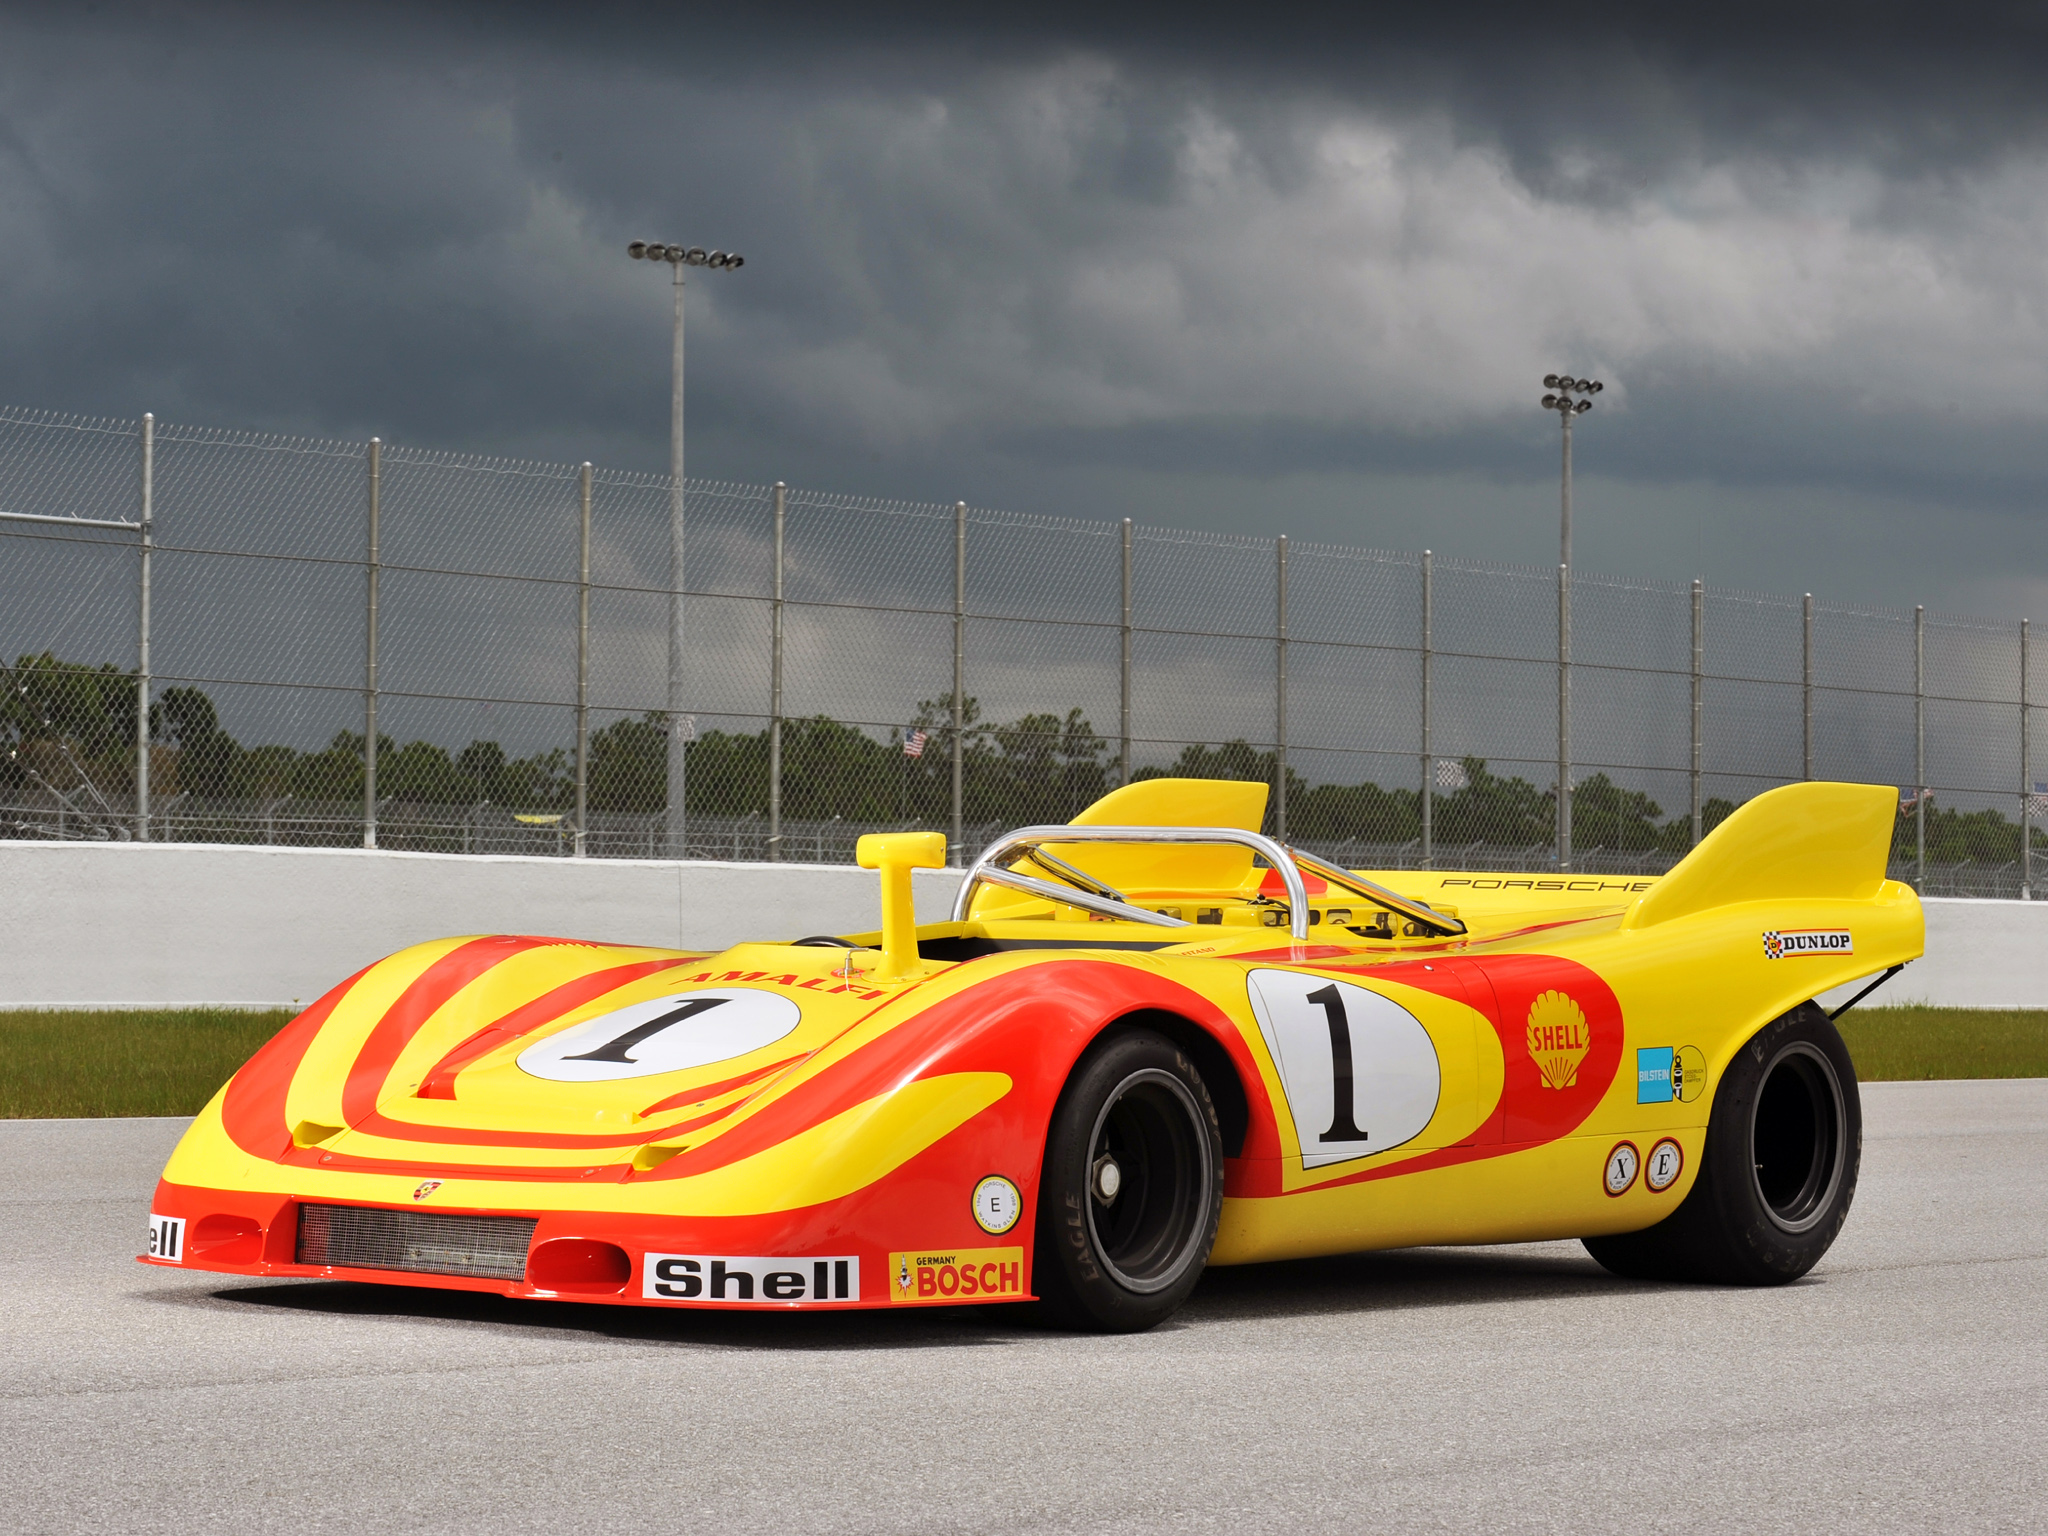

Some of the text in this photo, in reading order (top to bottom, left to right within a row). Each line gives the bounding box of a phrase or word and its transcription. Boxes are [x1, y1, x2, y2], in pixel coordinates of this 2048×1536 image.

[1440, 879, 1653, 892] PORSCHE
[1783, 935, 1850, 950] DUNLOP
[669, 970, 889, 1001] AMALFI
[559, 997, 735, 1064] 1
[1533, 1024, 1583, 1052] SHELL
[1306, 983, 1369, 1143] 1
[1639, 1068, 1670, 1083] BILSTEIN
[1613, 1157, 1629, 1179] X
[1657, 1153, 1671, 1176] E
[982, 1180, 1006, 1191] PORSCHE
[990, 1197, 1001, 1213] E
[978, 1211, 1001, 1229] WATKINS
[149, 1220, 179, 1257] ell
[916, 1255, 956, 1266] GERMANY
[654, 1258, 849, 1300] Shell
[917, 1261, 1019, 1297] BOSCH
